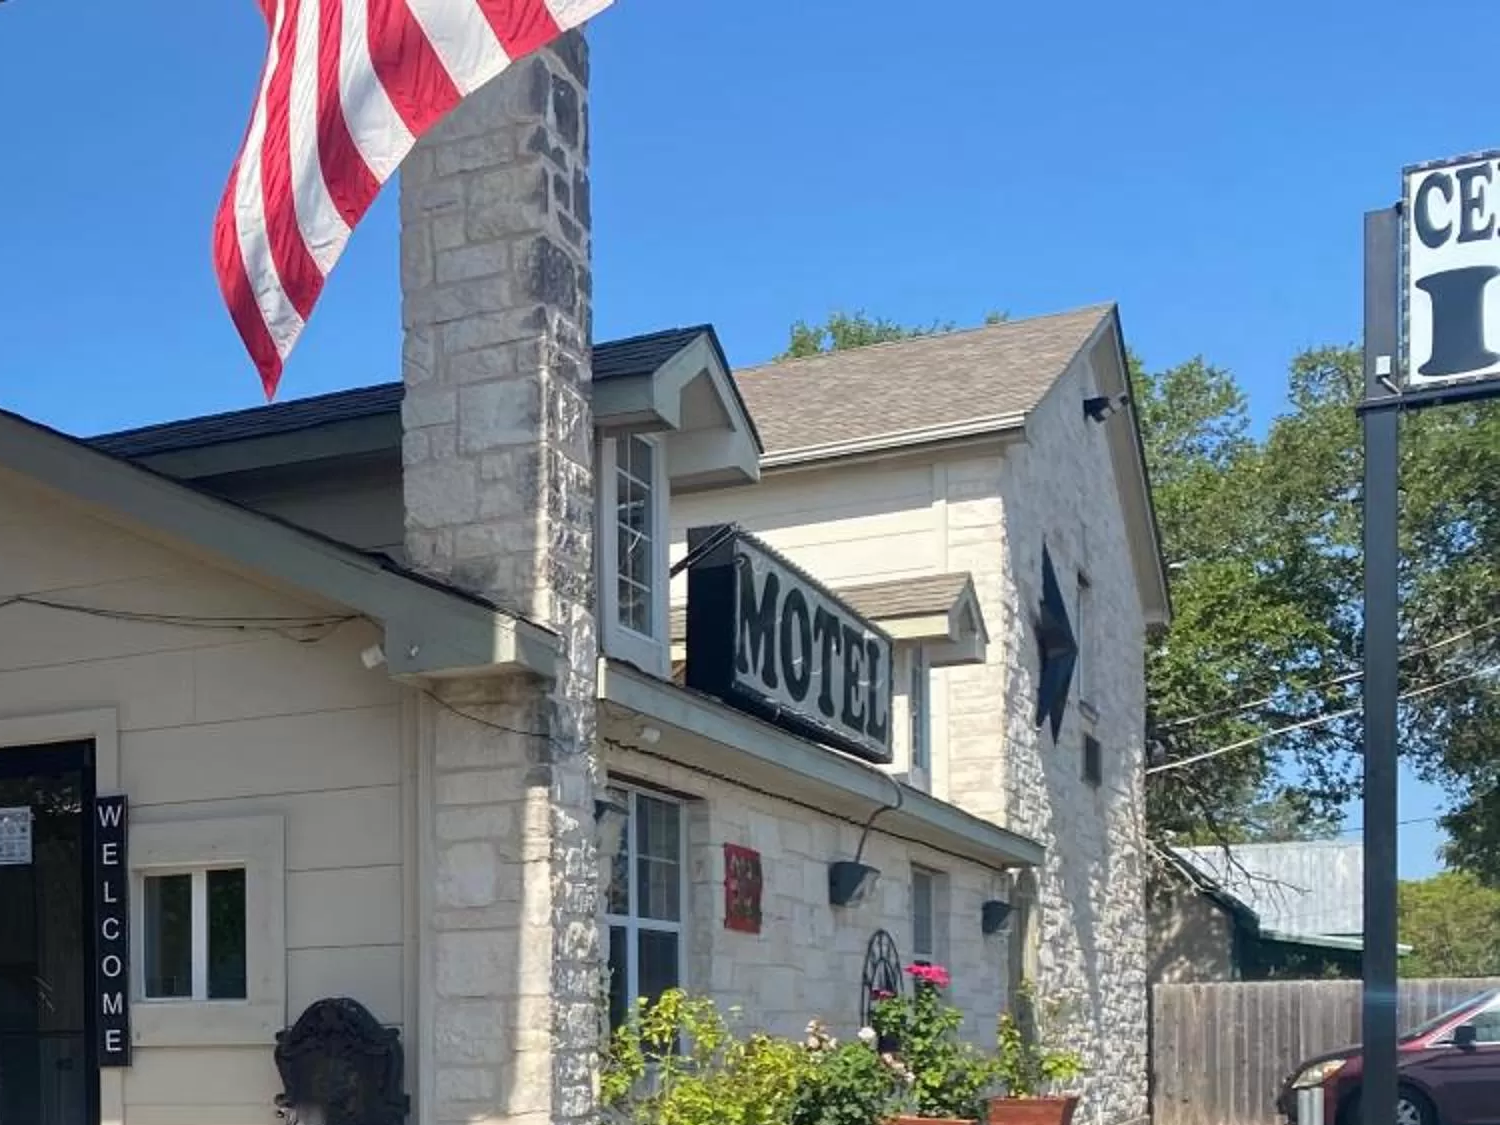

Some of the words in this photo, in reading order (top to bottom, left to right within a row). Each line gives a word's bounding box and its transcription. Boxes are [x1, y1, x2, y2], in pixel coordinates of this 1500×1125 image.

[1413, 161, 1500, 249] CE
[735, 552, 887, 744] MOTEL
[97, 804, 124, 1052] WELCOME
